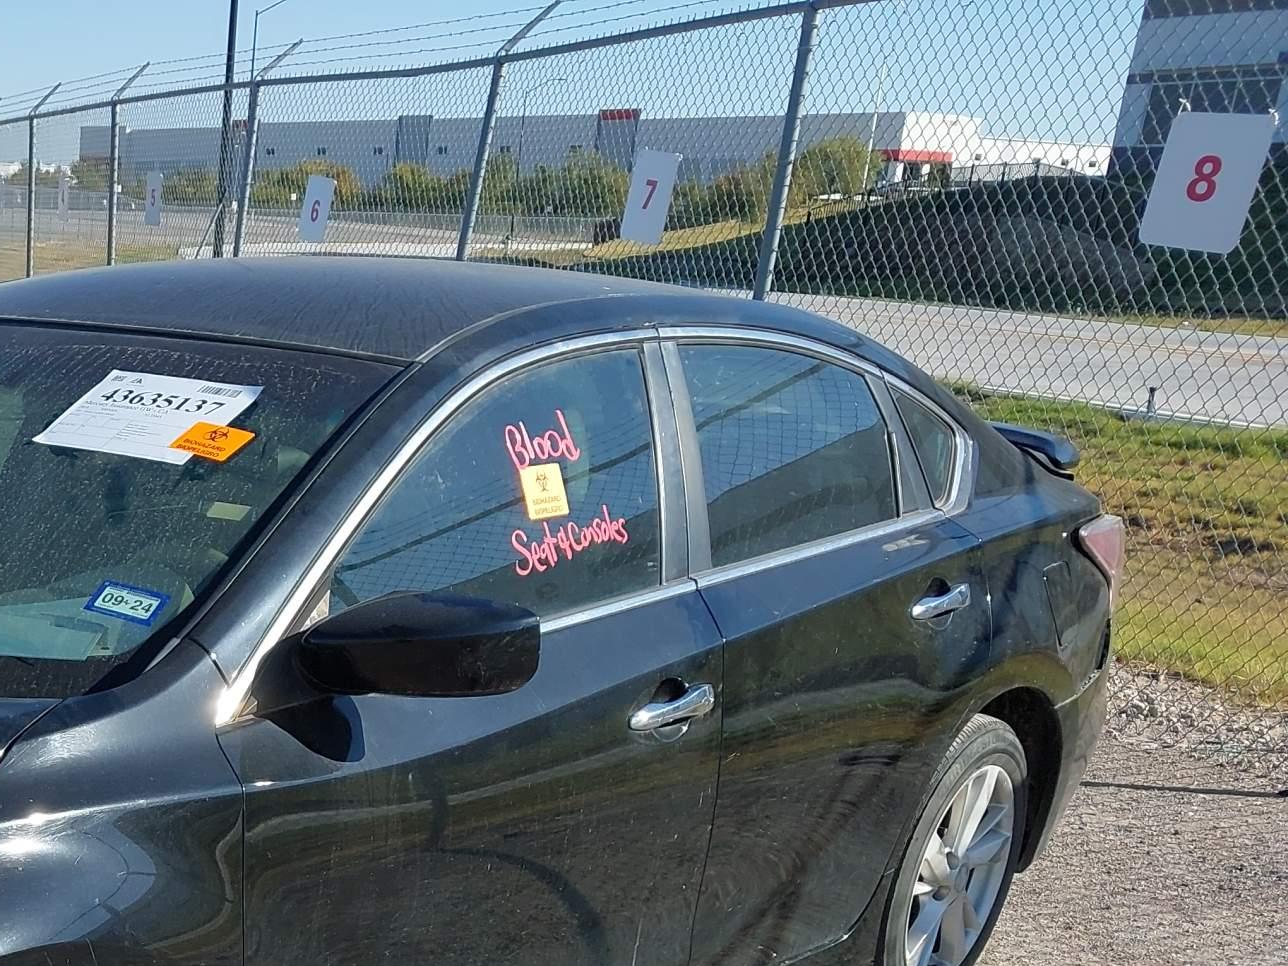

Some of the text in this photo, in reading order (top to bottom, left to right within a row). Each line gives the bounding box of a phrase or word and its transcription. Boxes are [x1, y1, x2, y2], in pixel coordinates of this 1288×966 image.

[641, 178, 659, 210] 7
[1185, 153, 1223, 203] 8
[150, 187, 157, 208] 5
[310, 199, 321, 223] 6
[100, 387, 227, 416] 43635137
[504, 408, 581, 471] Blood
[511, 520, 558, 576] Seat
[567, 504, 628, 551] Consoles
